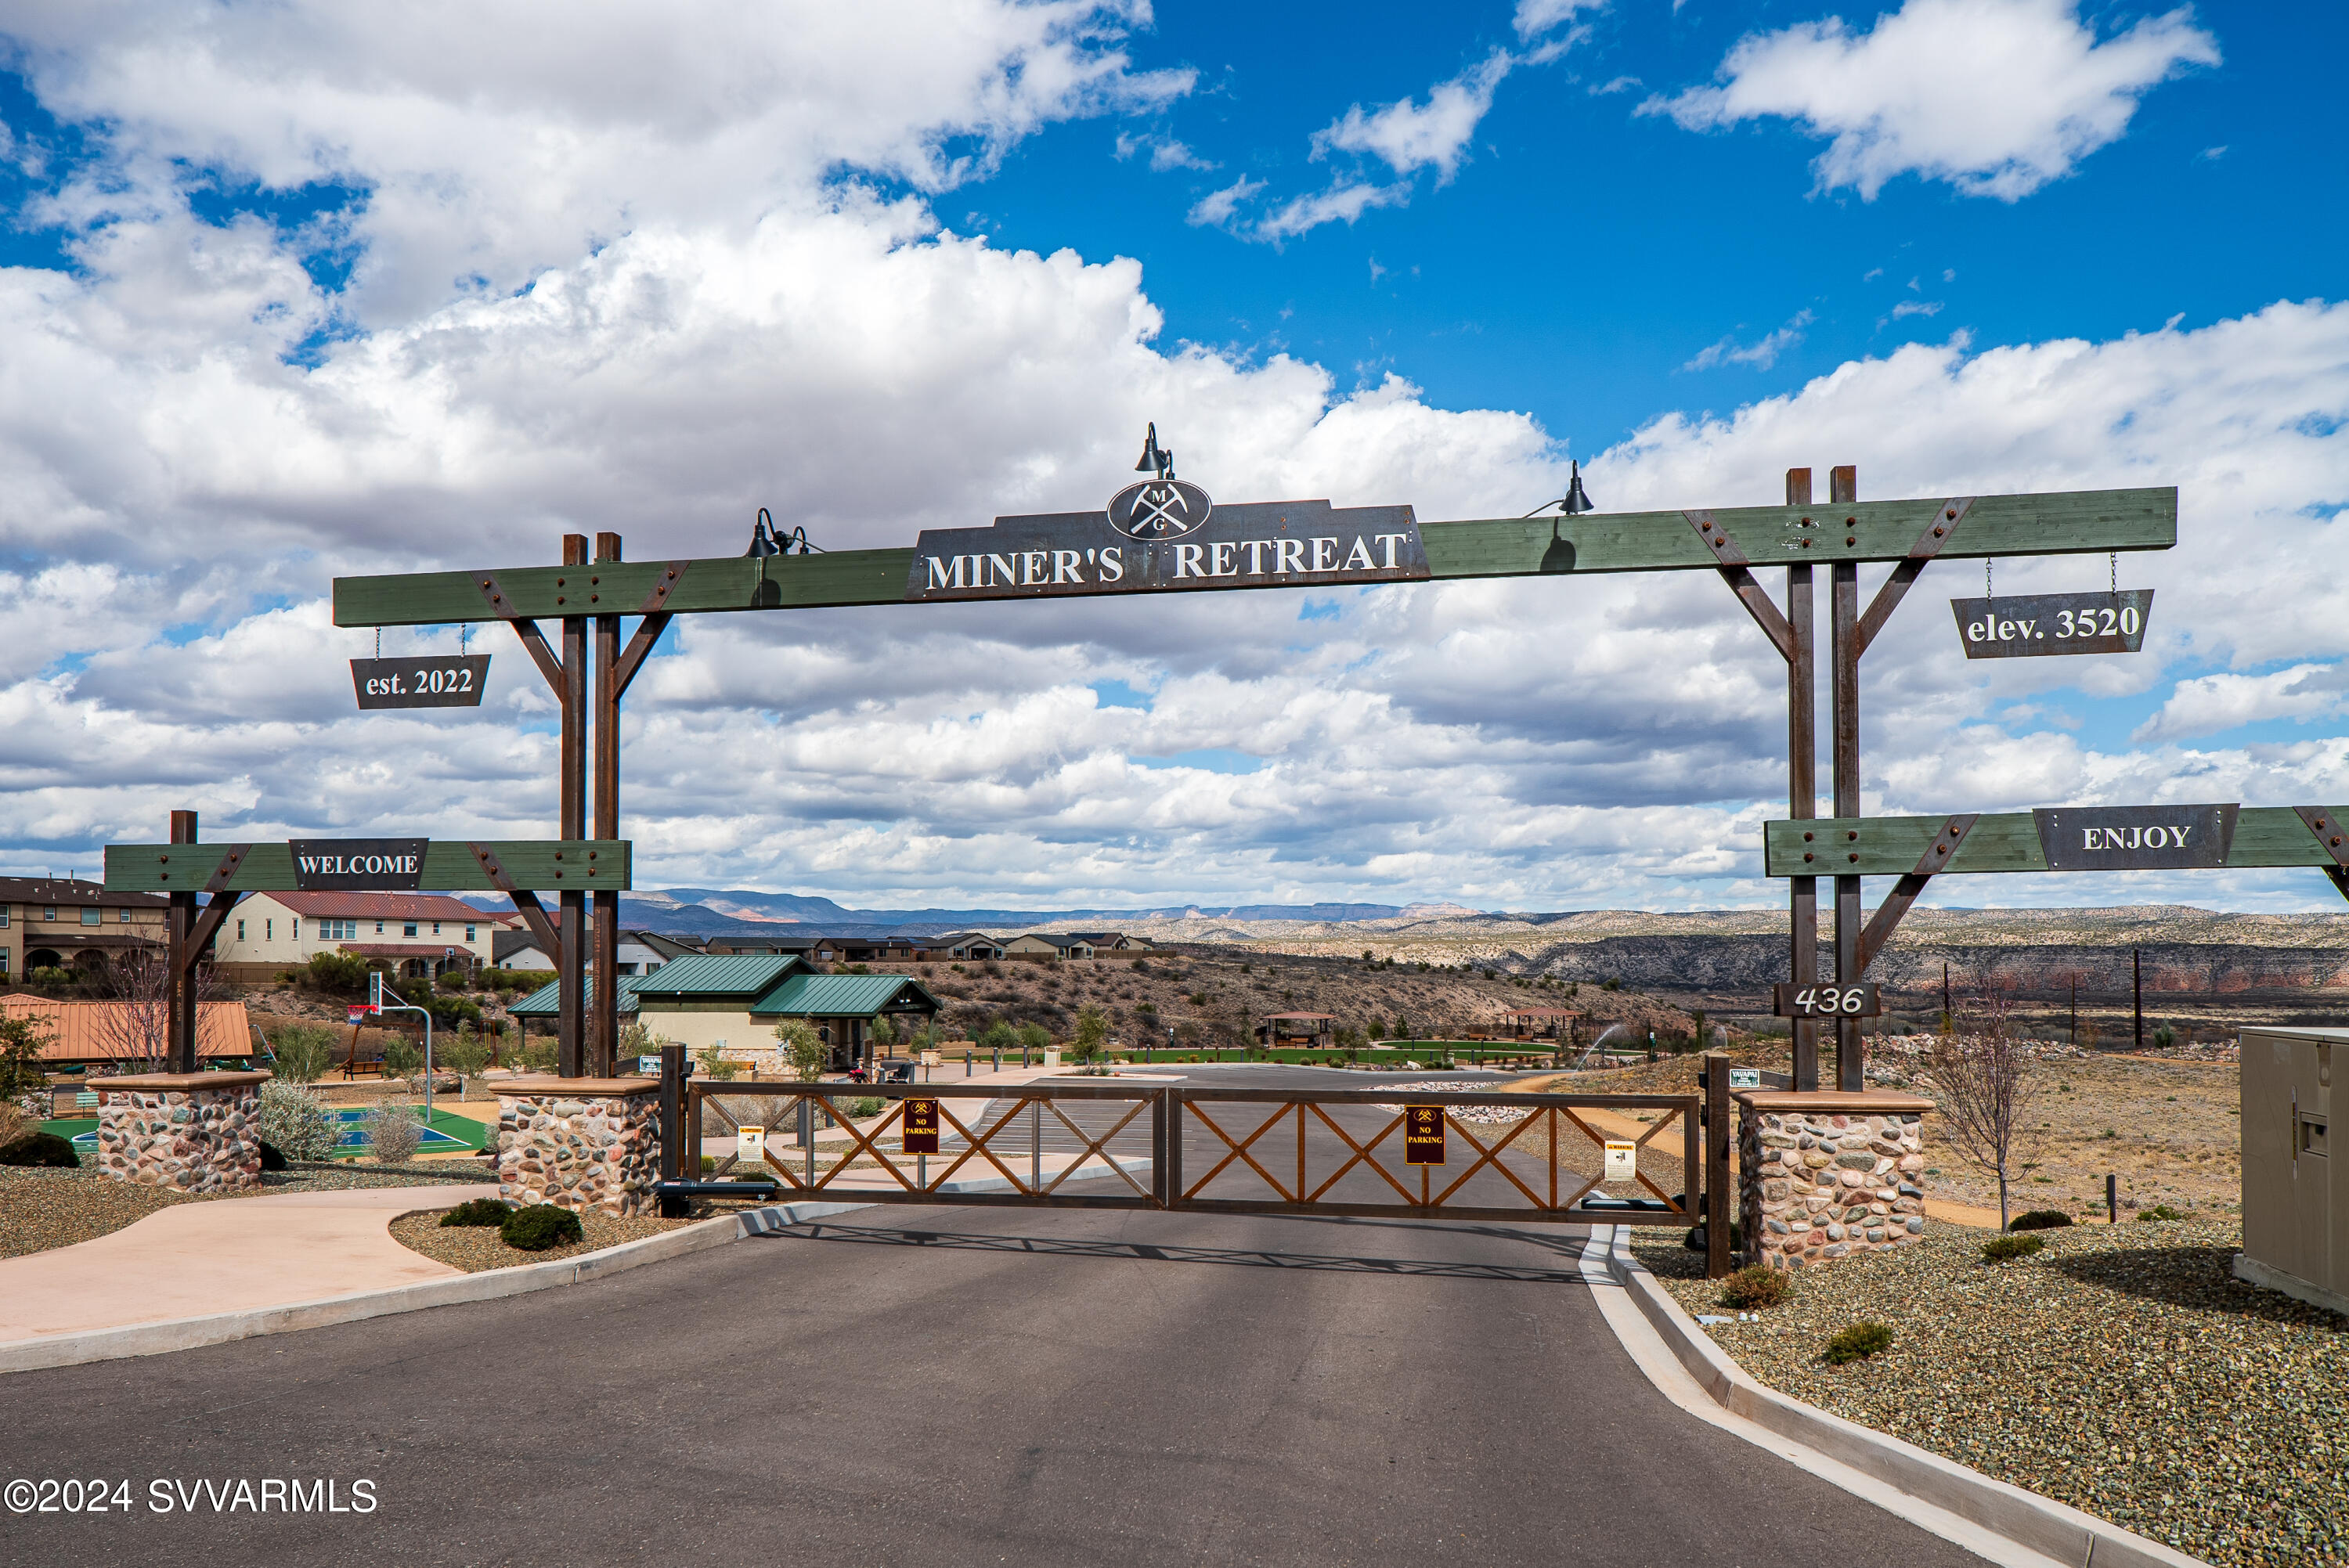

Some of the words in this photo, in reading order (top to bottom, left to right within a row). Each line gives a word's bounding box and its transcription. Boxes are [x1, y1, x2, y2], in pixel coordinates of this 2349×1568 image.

[1151, 490, 1167, 502] M
[1153, 517, 1166, 531] G
[925, 547, 1124, 590] MINER'S
[1172, 534, 1408, 579] RETREAT
[1967, 614, 2044, 642] elev.
[2055, 607, 2140, 639] 3520
[366, 672, 407, 695] est.
[413, 669, 473, 694] 2022
[2081, 826, 2192, 850] ENJOY
[298, 856, 418, 874] WELCOME
[1795, 988, 1864, 1014] 436
